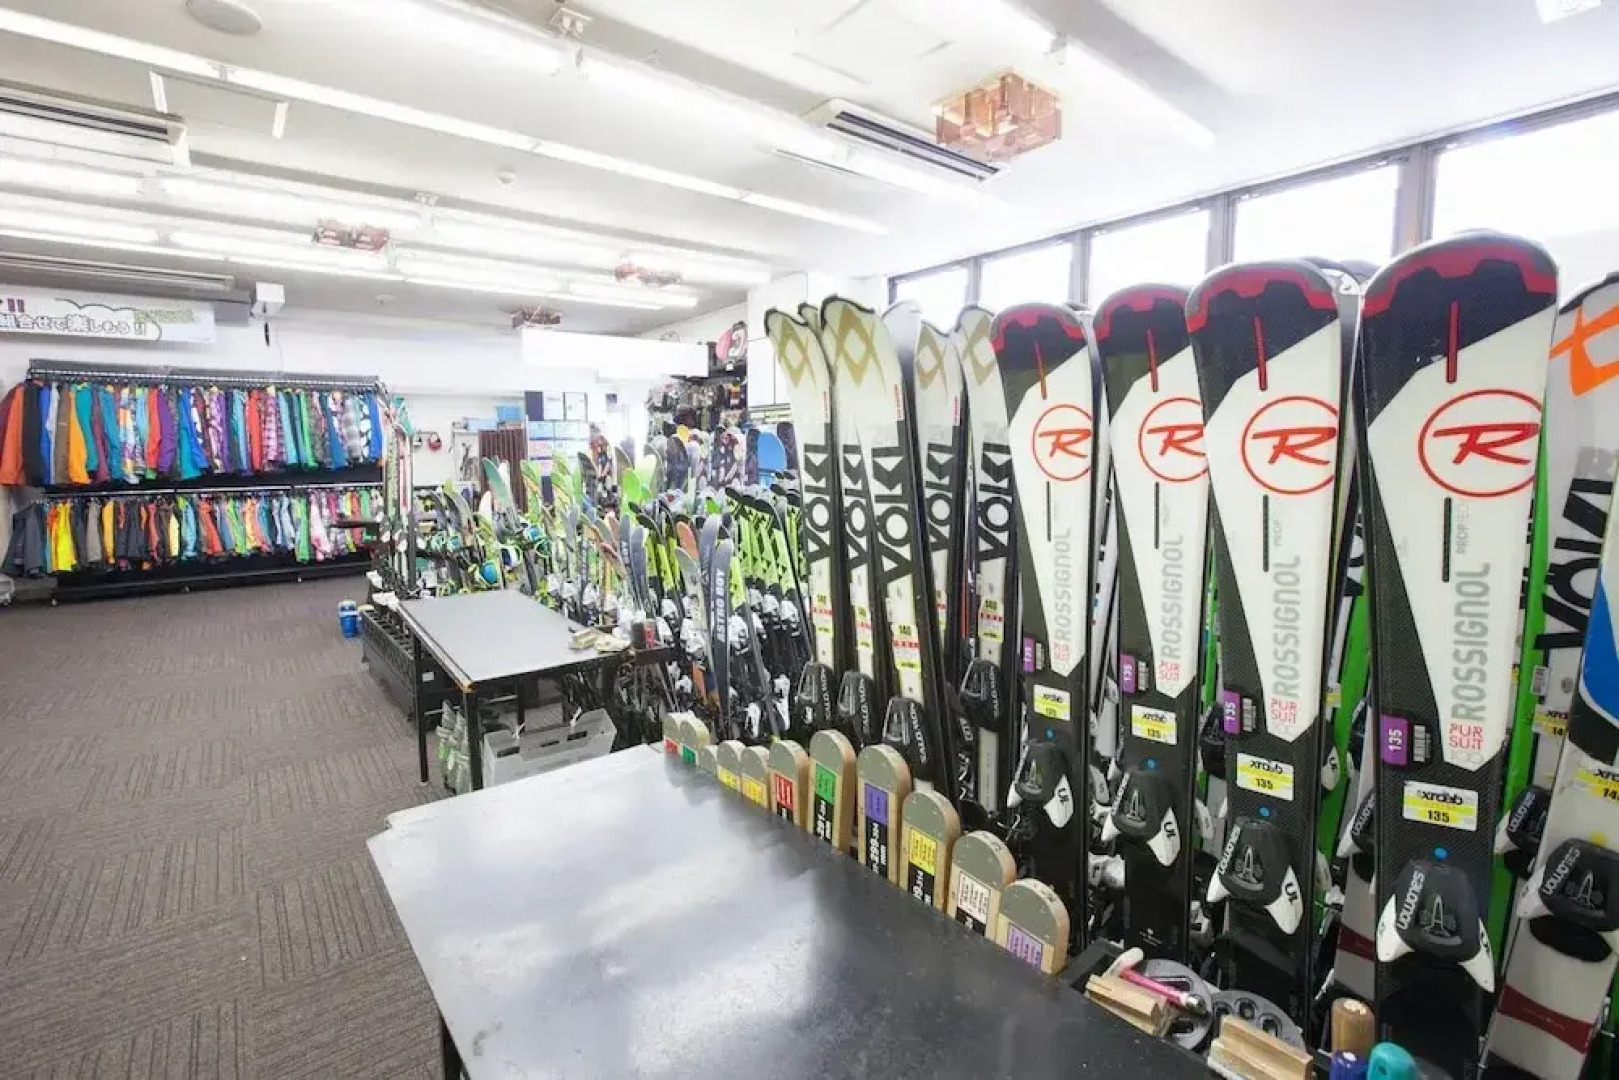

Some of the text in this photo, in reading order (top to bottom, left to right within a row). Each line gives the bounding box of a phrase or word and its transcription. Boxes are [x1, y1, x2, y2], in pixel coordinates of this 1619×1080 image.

[1252, 426, 1337, 464] R
[1433, 423, 1539, 465] R
[1053, 527, 1073, 642] ROSSIGNOL
[1160, 535, 1185, 660] ROSSIGNOL
[1273, 555, 1301, 699] ROSSIGNOL
[1452, 562, 1492, 721] ROSSIGNOL
[1225, 701, 1236, 721] 135
[1449, 723, 1483, 736] PUR
[1388, 728, 1403, 751] 135
[1256, 778, 1273, 790] 135
[1428, 810, 1450, 823] 135
